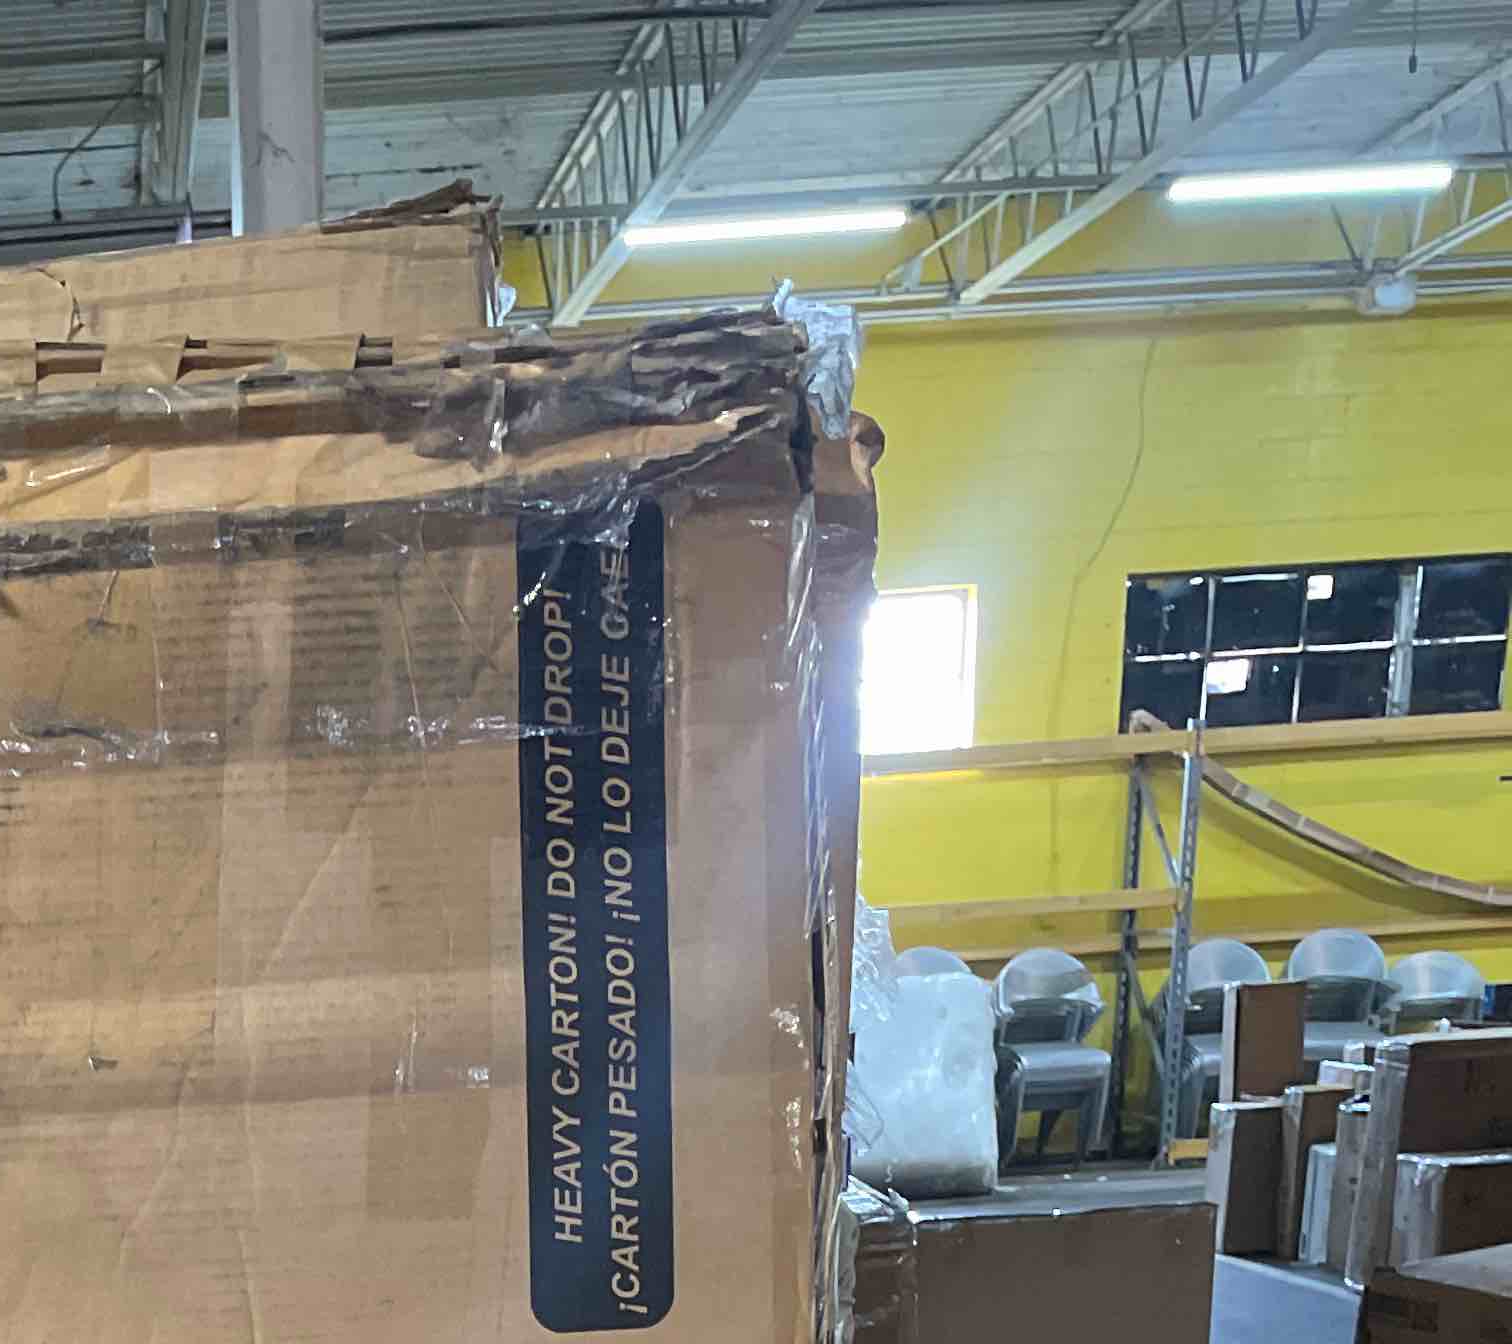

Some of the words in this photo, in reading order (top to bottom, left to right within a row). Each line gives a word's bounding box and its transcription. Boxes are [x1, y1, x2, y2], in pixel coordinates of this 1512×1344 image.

[541, 586, 574, 729] DROP!
[599, 653, 632, 766] DEJE
[541, 736, 577, 826] NOT
[599, 776, 633, 833] LO
[544, 833, 578, 899] DO
[602, 842, 641, 923] ¡NO
[546, 910, 581, 1097] CARTON!
[603, 934, 639, 1119] PESADO!
[549, 1104, 585, 1243] HEAVY
[599, 1130, 650, 1316] ¡CARTÓN
